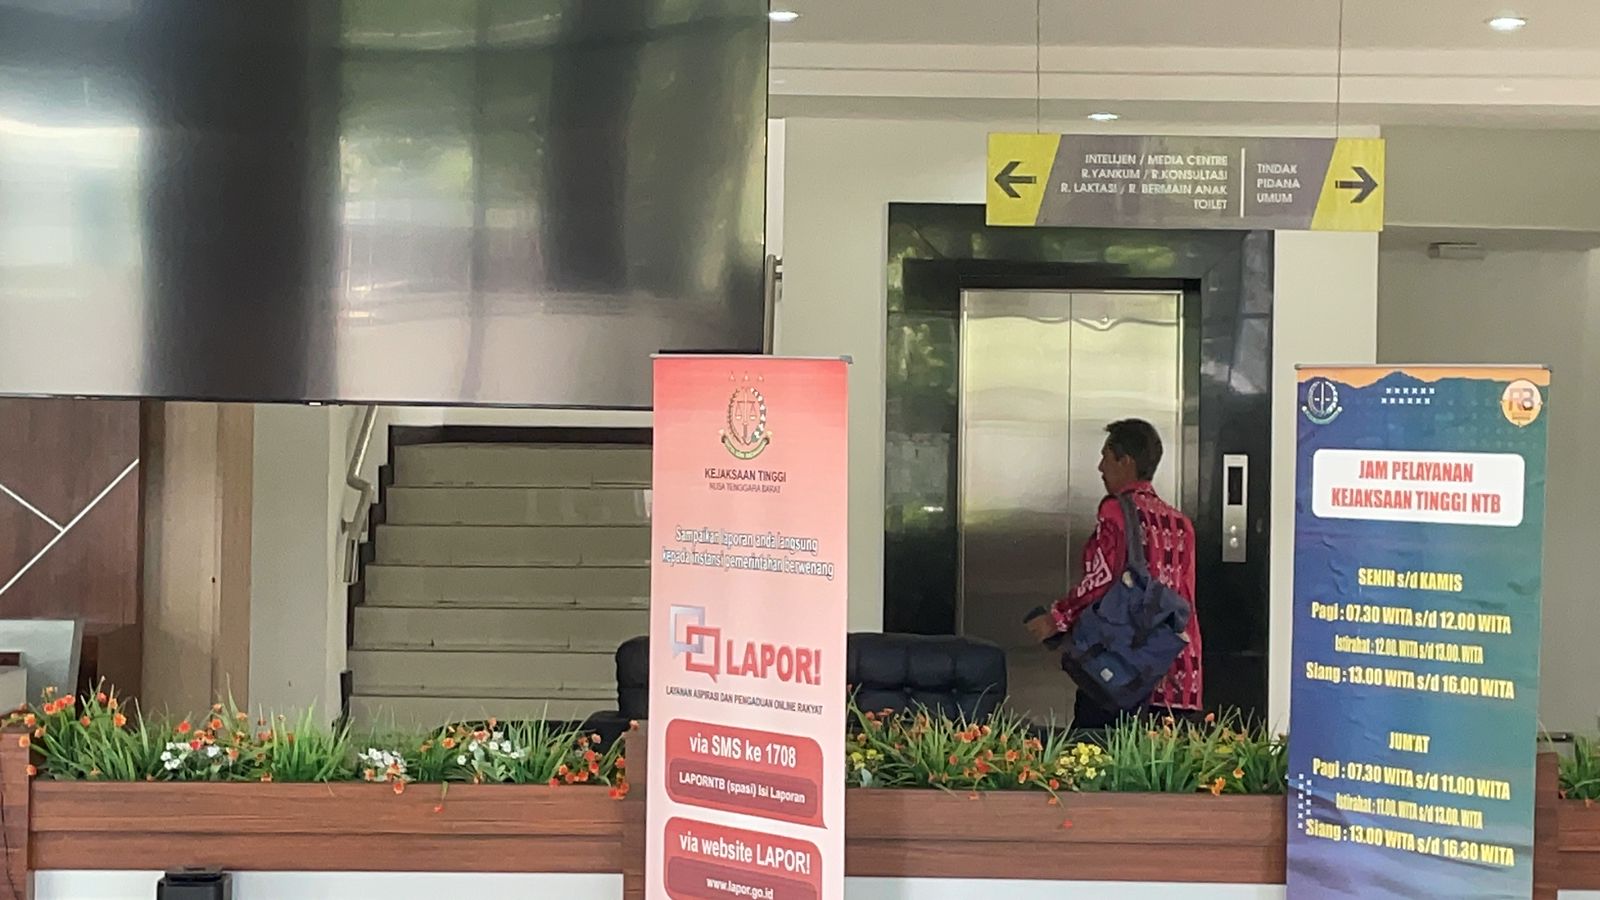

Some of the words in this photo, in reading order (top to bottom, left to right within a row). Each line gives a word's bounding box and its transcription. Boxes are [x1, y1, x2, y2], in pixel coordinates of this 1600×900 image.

[1085, 154, 1136, 165] INTELIJEN
[1147, 154, 1184, 165] MEDIA
[1186, 155, 1228, 166] CENTRE
[1257, 163, 1297, 174] TINDAK
[1060, 183, 1071, 193] R.
[1074, 183, 1118, 194] LAKTASI
[1141, 184, 1192, 195] BERMAIN
[1194, 184, 1228, 195] ANAK
[1257, 178, 1301, 189] PIDANA
[1194, 199, 1228, 210] TOILET
[1257, 193, 1293, 203] UMUM
[705, 468, 756, 480] KEJAKSAAN
[758, 470, 787, 482] TINGGI
[1359, 460, 1389, 480] JAM
[1392, 461, 1474, 483] PELAYANAN
[709, 482, 725, 491] NUSA
[1331, 487, 1413, 510] KEJAKSAAN
[1415, 490, 1467, 512] TINGGI
[1471, 492, 1501, 514] NTB
[675, 525, 719, 546] Sampaikan
[721, 528, 753, 549] laporan
[755, 532, 776, 549] anda
[777, 532, 818, 556] langsung
[662, 546, 691, 567] kepada
[725, 552, 783, 572] pemerintahan
[784, 555, 834, 580] berwenang
[1358, 567, 1395, 588] SENIN
[1397, 570, 1419, 589] s/d
[1420, 572, 1463, 592] KAMIS
[1311, 601, 1339, 622] Pagi
[1345, 603, 1380, 624] 07.30
[1383, 606, 1414, 627] WITA
[1415, 610, 1437, 628] s/d
[1439, 611, 1475, 632] 12.00
[1478, 614, 1512, 635] WITA
[726, 639, 822, 686] LAPOR!
[1335, 634, 1371, 654] Istirahat
[1398, 639, 1418, 659] WITA
[1419, 641, 1434, 660] s/d
[1461, 645, 1484, 665] WITA
[1305, 661, 1340, 684] Siang
[1348, 665, 1383, 687] 13.00
[1384, 669, 1415, 690] WITA
[1416, 673, 1439, 692] s/d
[1441, 674, 1479, 696] 16.00
[1481, 678, 1515, 700] WITA
[666, 685, 693, 698] LAYANAN
[693, 689, 720, 702] ASPIRASI
[720, 692, 733, 704] DAN
[734, 694, 774, 708] PENGADUAN
[774, 700, 796, 712] ONLINE
[797, 702, 823, 715] RAKYAT
[689, 733, 709, 754] via
[711, 735, 742, 760] SMS
[745, 739, 762, 762] ke
[765, 743, 797, 768] 1708
[1388, 731, 1431, 753] JUM'AT
[679, 771, 726, 790] LAPORNTB
[727, 779, 757, 798] (spasi)
[758, 783, 769, 797] Isi
[770, 786, 806, 805] Laporan
[1312, 757, 1340, 779] Pagi
[1347, 762, 1382, 783] 07.30
[1383, 766, 1414, 788] WITA
[1415, 771, 1439, 791] s/d
[1440, 774, 1475, 796] 11.00
[1477, 779, 1511, 801] WITA
[1336, 792, 1372, 813] Istirahat
[1398, 800, 1418, 820] WITA
[1419, 803, 1434, 823] s/d
[1460, 808, 1483, 830] WITA
[679, 831, 699, 853] via
[701, 836, 753, 863] website
[756, 843, 811, 875] LAPOR!
[1305, 818, 1342, 842] Siang
[1349, 824, 1383, 847] 13.00
[1384, 830, 1415, 852] WITA
[1416, 835, 1440, 857] s/d
[1442, 838, 1479, 860] 16.30
[1481, 843, 1515, 867] WITA
[706, 877, 774, 900] www.lapor.go.id
